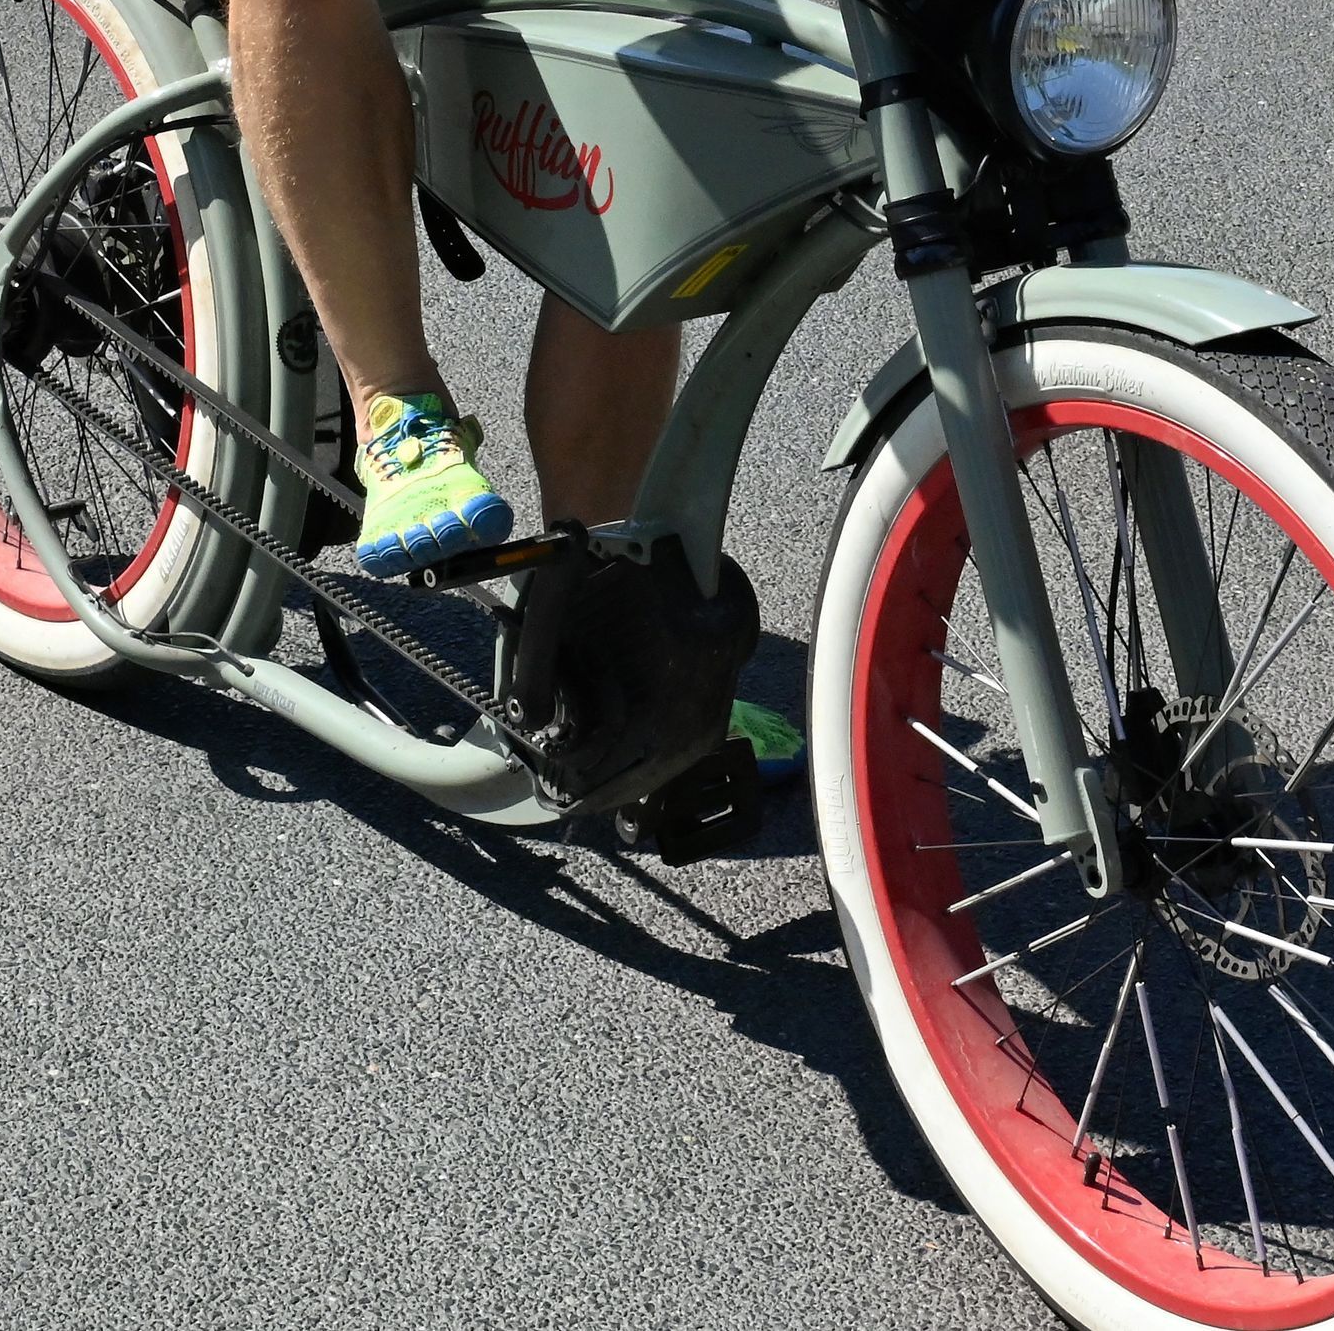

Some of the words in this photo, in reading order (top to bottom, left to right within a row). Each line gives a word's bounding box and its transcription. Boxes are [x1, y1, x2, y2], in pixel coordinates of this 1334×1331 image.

[472, 90, 614, 216] Ruffian
[1048, 361, 1102, 387] Custom
[1103, 363, 1145, 397] Bikes
